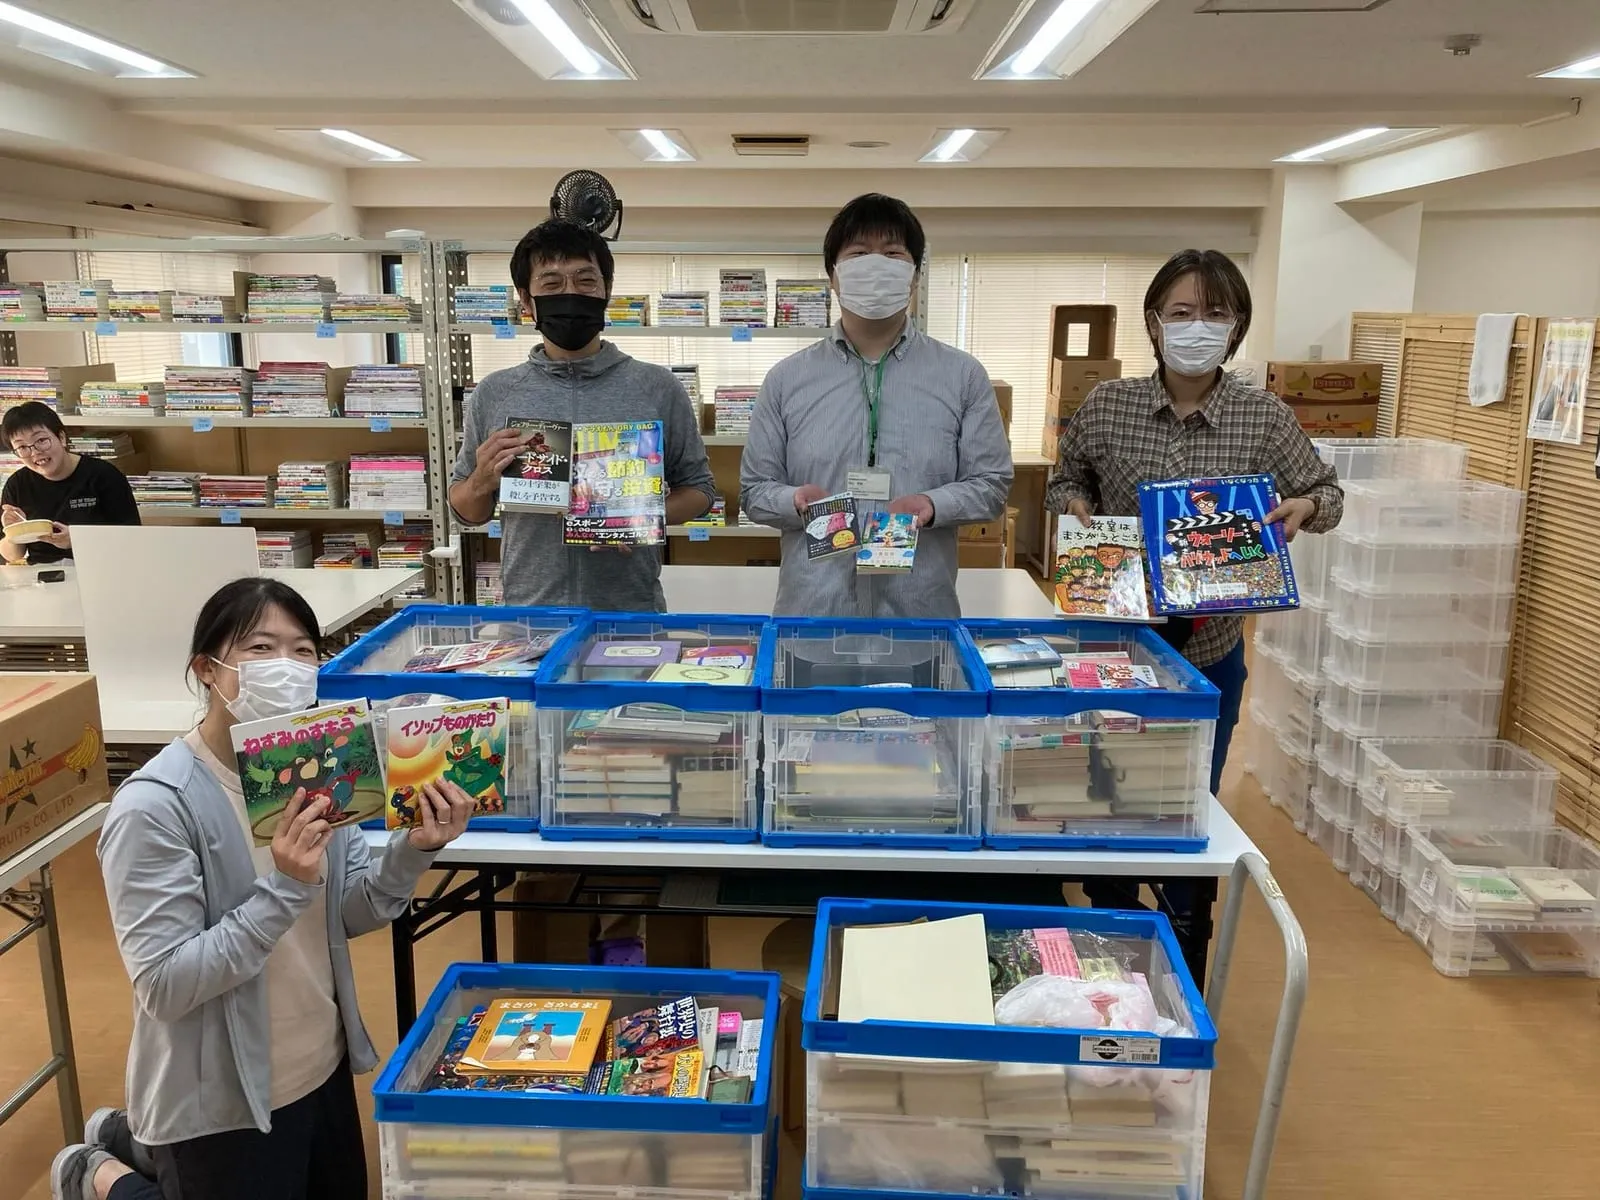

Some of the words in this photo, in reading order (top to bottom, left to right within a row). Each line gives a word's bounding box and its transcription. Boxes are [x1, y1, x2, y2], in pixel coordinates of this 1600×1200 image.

[516, 452, 568, 466] ードサイド・
[521, 464, 553, 475] クロス
[1090, 519, 1132, 533] 教室は
[1063, 530, 1145, 542] まちがうところ
[1187, 527, 1244, 548] ウォーリー
[1180, 543, 1265, 569] ハリウッドへいく
[401, 712, 496, 737] イソップものがたり
[243, 717, 356, 756] ねずみのすもう
[499, 1001, 537, 1010] まさか
[676, 996, 695, 1039] 世界史の
